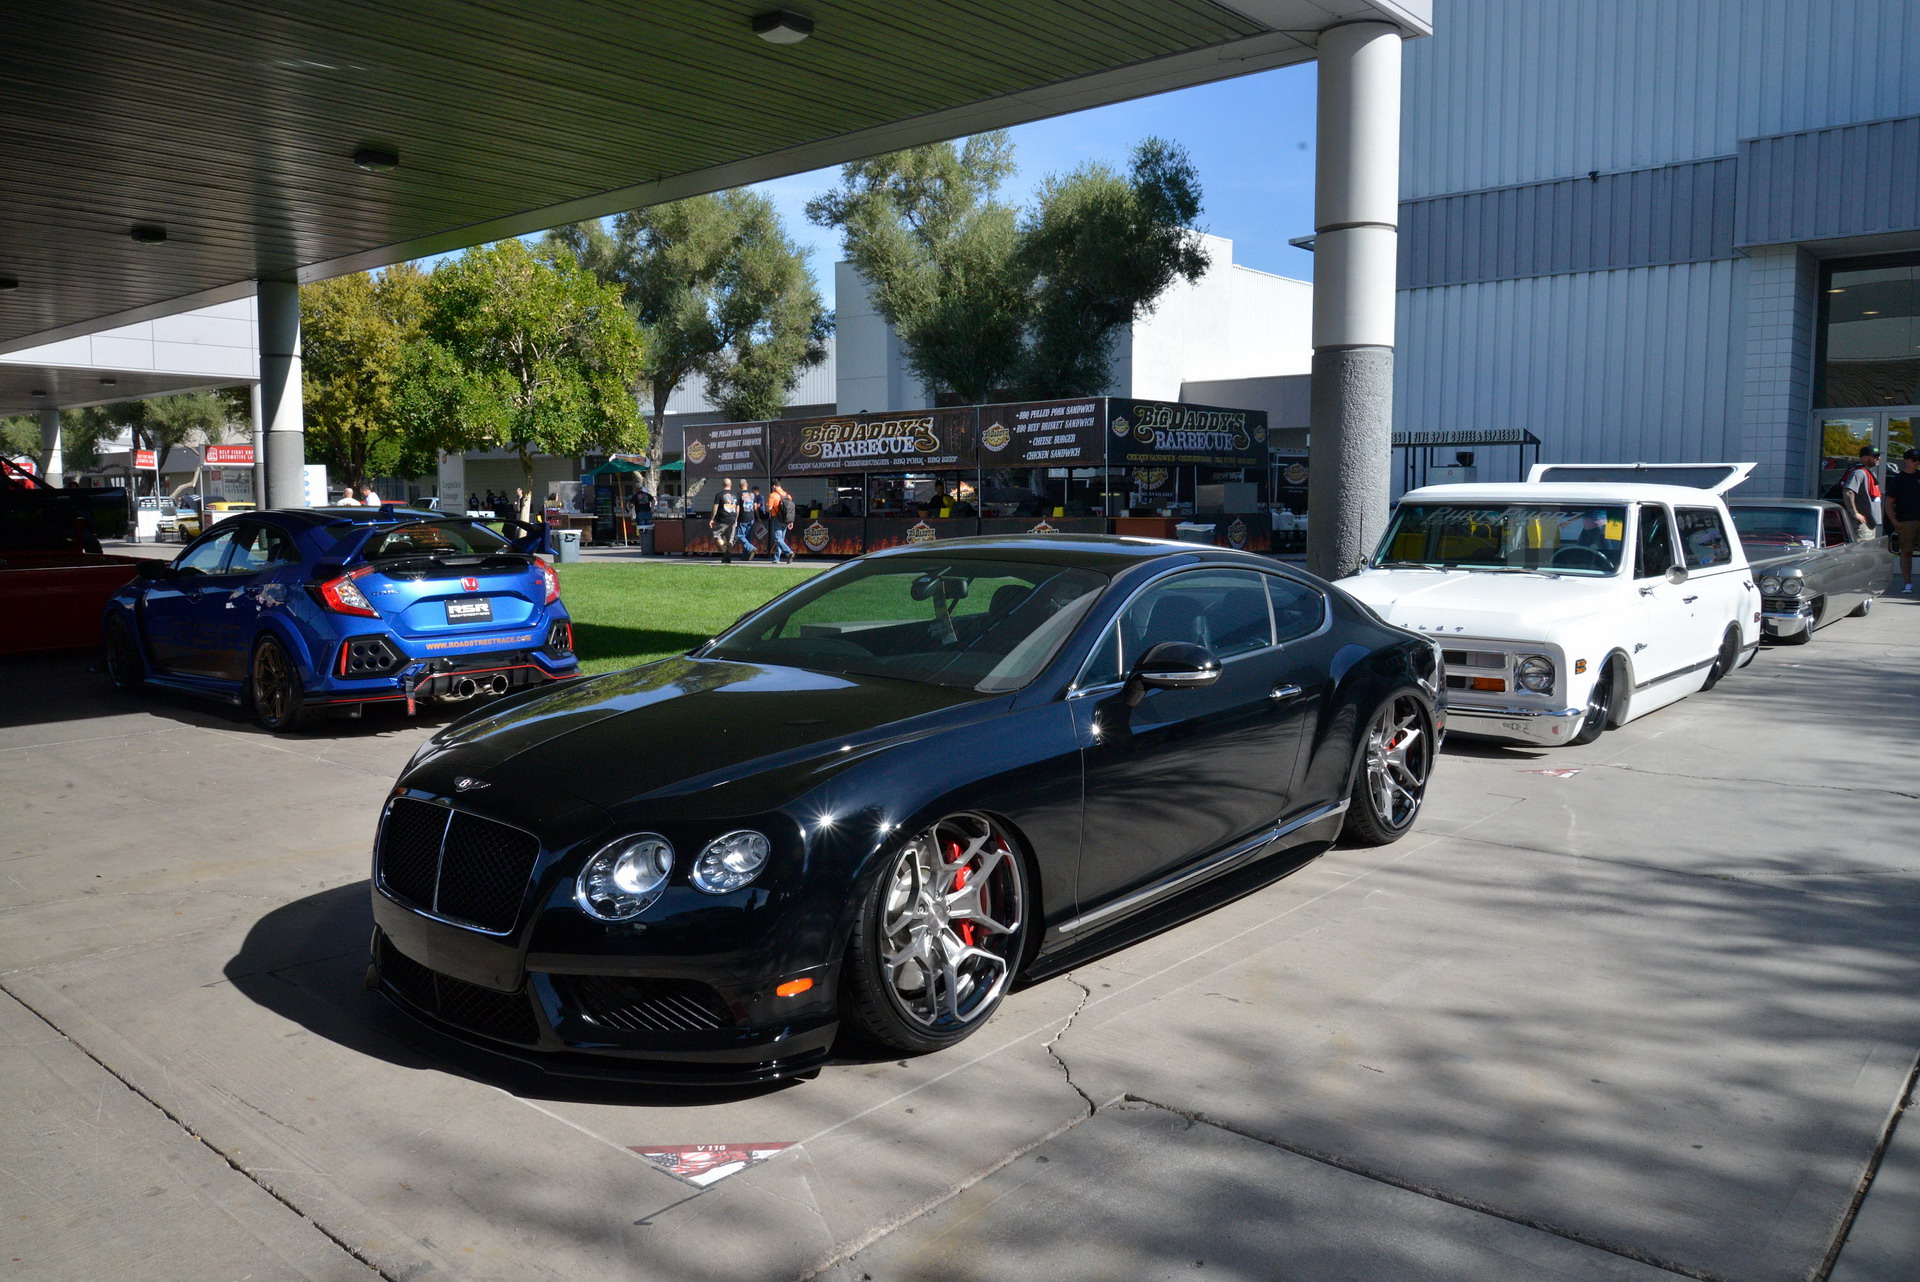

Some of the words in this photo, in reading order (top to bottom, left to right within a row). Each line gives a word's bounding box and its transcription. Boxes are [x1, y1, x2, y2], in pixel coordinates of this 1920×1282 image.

[1019, 411, 1030, 420] BBQ
[1030, 409, 1050, 419] PULLED
[1050, 407, 1065, 417] PORK
[1065, 404, 1096, 415] SANDWICH
[742, 426, 762, 435] SANDWICH
[1016, 425, 1027, 433] BBQ
[1027, 423, 1041, 432] BEEF
[1041, 420, 1065, 431] BRISKET
[1064, 417, 1095, 429] SANDWICH
[742, 437, 762, 447] SANDWICH
[1032, 435, 1053, 446] CHEESE
[1053, 434, 1076, 444] BURGER
[1154, 431, 1233, 451] BARBECUE
[1414, 431, 1429, 443] FIVE
[1431, 431, 1449, 442] SPOT
[1451, 430, 1476, 442] COFFEE
[1483, 428, 1521, 441] ESPRESSO
[821, 436, 915, 459] BARBECUE
[1026, 450, 1049, 460] CHICKEN
[1049, 447, 1081, 459] SANDWICH
[733, 462, 754, 470] SANDWICH
[811, 461, 841, 469] SANDWICH
[448, 603, 489, 614] RSR
[426, 634, 532, 650] WWW.ROADSTREETRACE.COM
